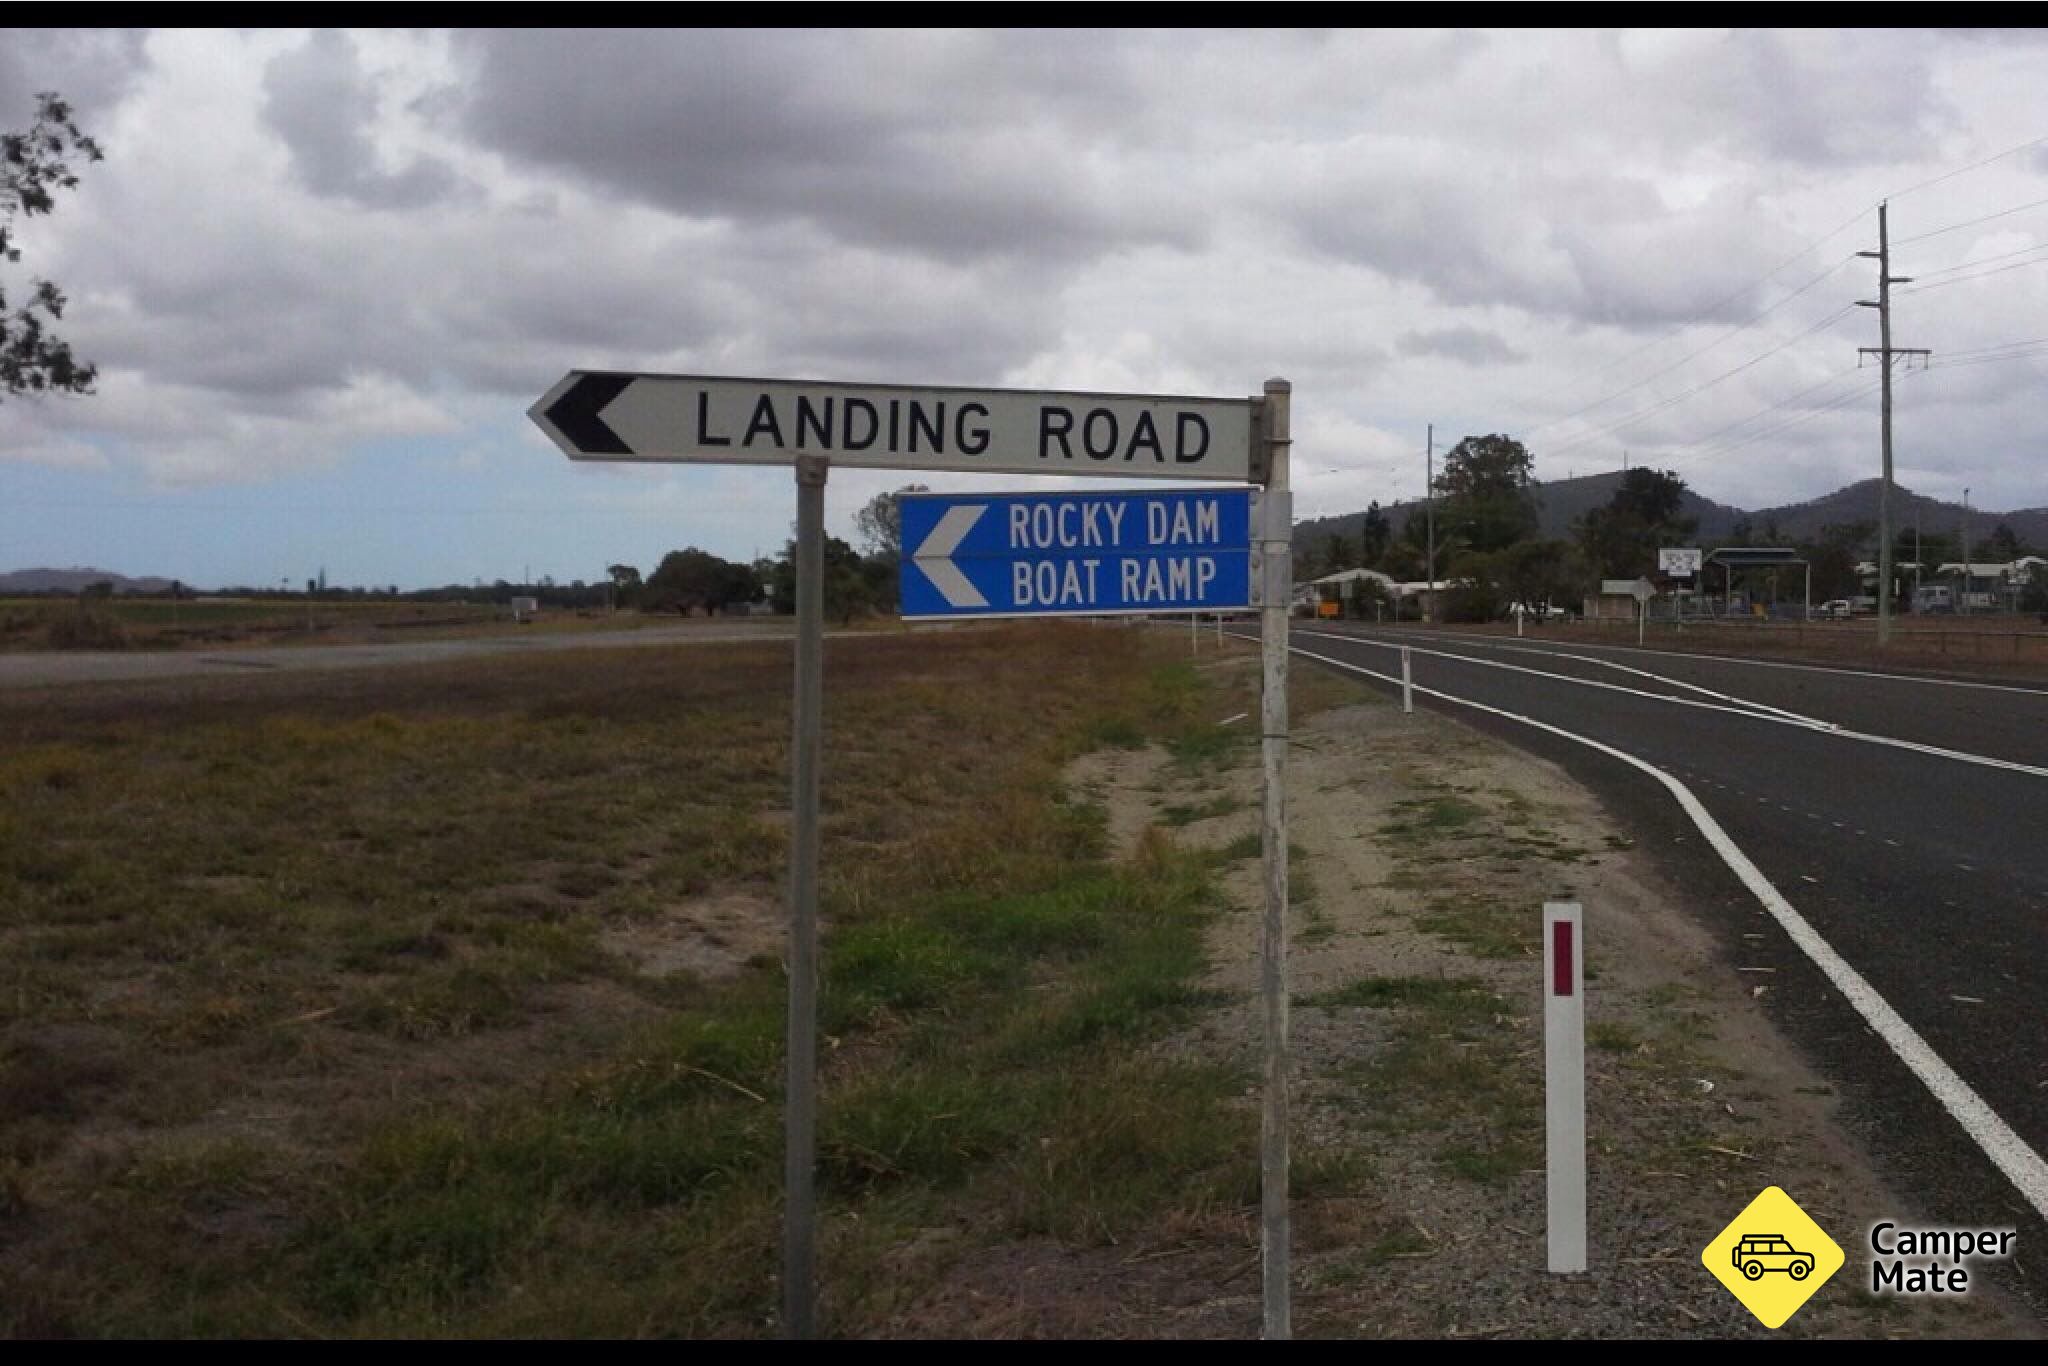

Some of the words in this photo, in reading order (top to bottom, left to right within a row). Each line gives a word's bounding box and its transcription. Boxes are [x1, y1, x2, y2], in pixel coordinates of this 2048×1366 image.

[697, 392, 991, 456] LANDING
[1038, 406, 1211, 464] ROAD
[1008, 501, 1126, 549] ROCKY
[1147, 499, 1221, 545] DAM
[1012, 560, 1100, 607] BOAT
[1121, 555, 1217, 603] RAMP
